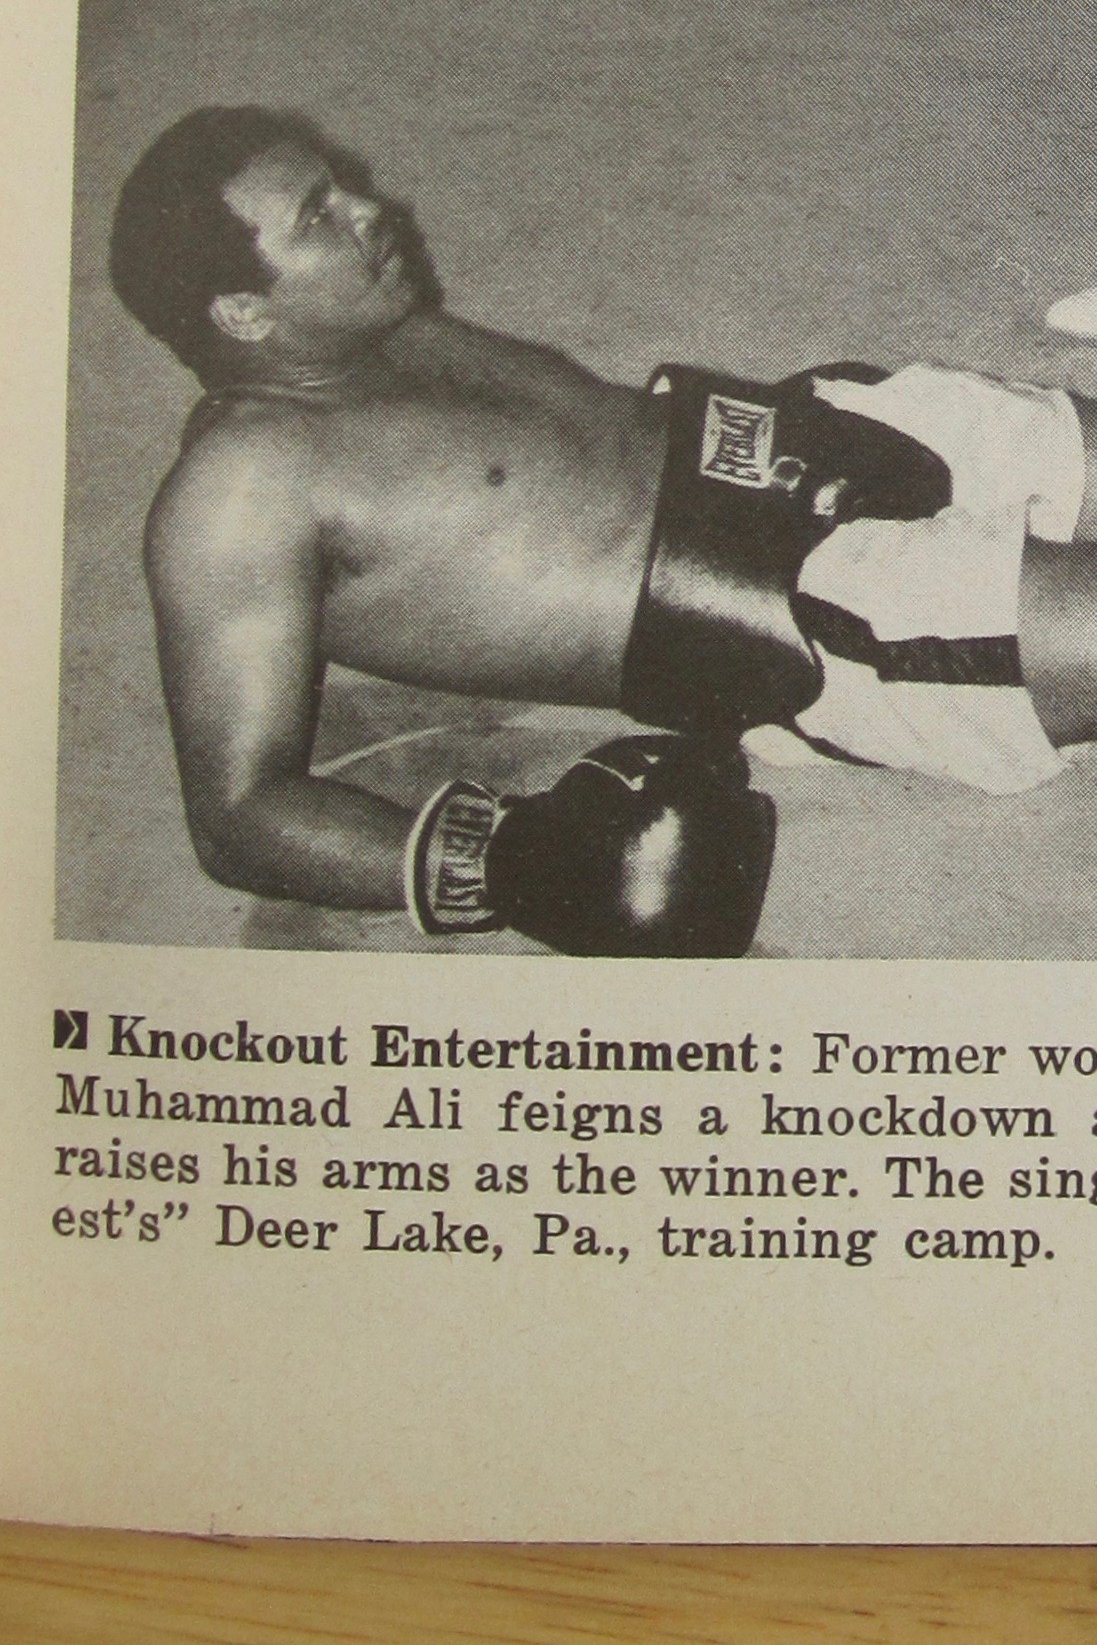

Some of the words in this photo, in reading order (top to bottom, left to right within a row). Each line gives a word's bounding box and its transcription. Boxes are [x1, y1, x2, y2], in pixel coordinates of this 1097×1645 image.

[107, 1014, 348, 1066] Knockout
[370, 1024, 783, 1074] Entertainment:
[812, 1032, 1007, 1075] Former
[56, 1073, 351, 1128] Muhammad
[383, 1086, 463, 1130] Ali
[498, 1090, 663, 1142] feigns
[698, 1105, 729, 1136] a
[761, 1092, 1058, 1138] knockdown
[54, 1138, 200, 1185] raises
[223, 1143, 298, 1188] his
[322, 1159, 451, 1193] arms
[475, 1162, 529, 1195] as
[552, 1152, 637, 1196] the
[659, 1155, 859, 1199] winner.
[885, 1155, 985, 1200] The
[215, 1204, 339, 1252] Deer
[363, 1208, 503, 1263] Lake,
[532, 1212, 630, 1265] Pa.,
[657, 1216, 879, 1268] training
[904, 1228, 1055, 1268] camp.
